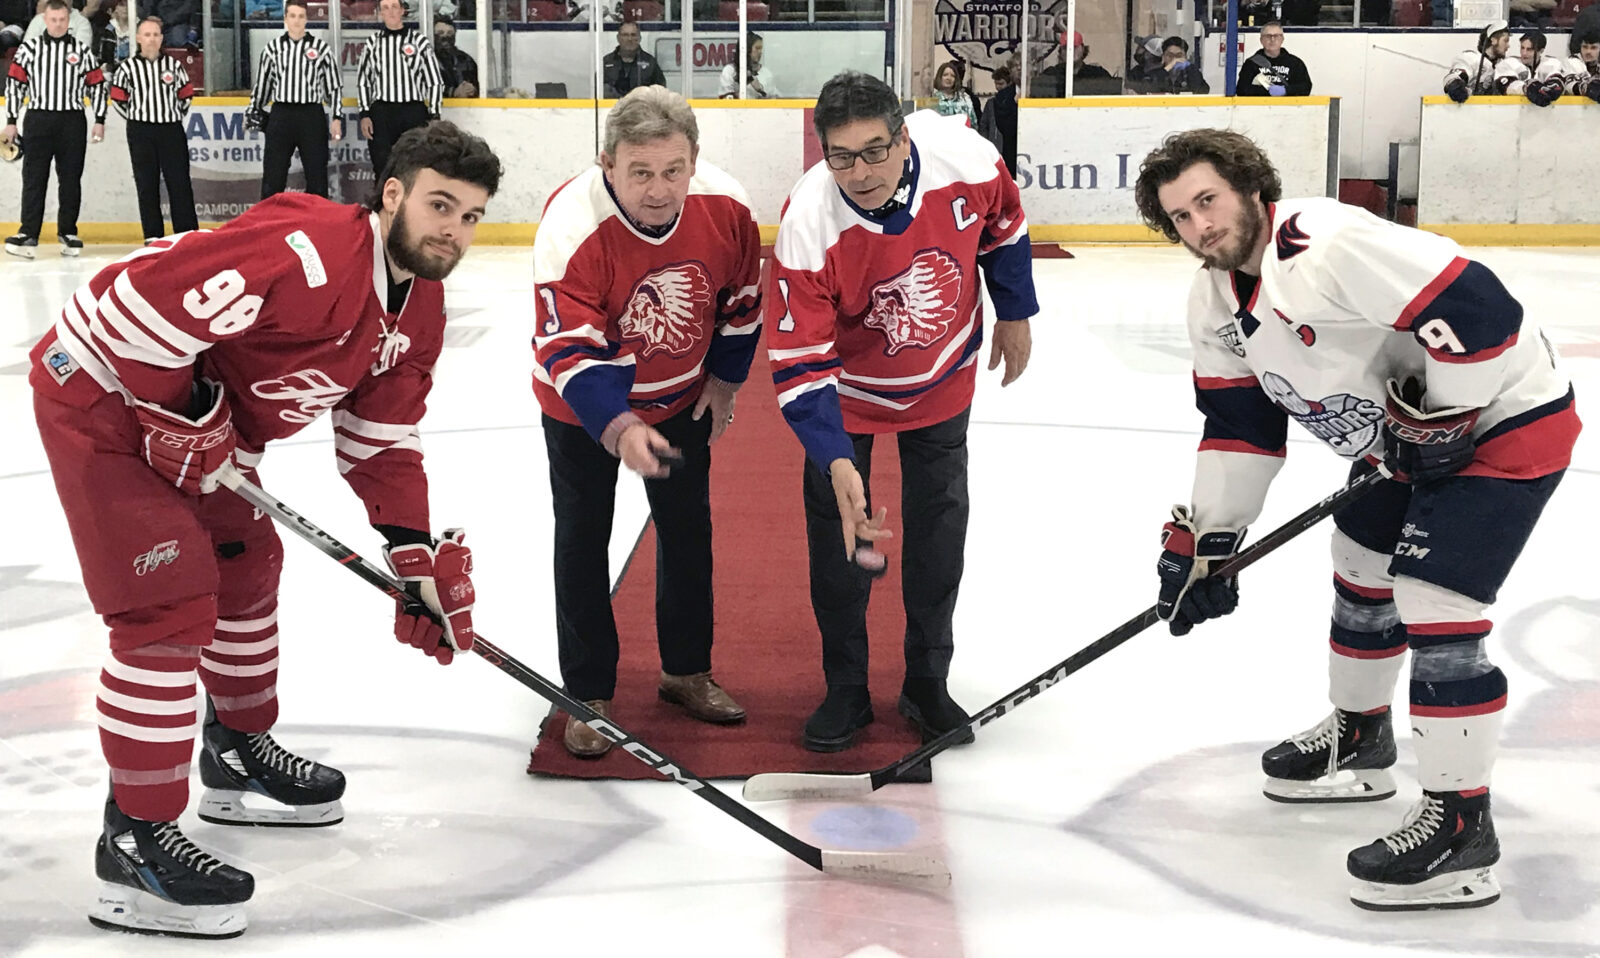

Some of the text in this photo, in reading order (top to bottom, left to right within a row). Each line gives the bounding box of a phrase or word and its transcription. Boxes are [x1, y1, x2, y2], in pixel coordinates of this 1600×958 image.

[631, 8, 643, 17] 14
[1573, 4, 1580, 13] 4
[223, 144, 262, 162] rent
[1016, 153, 1099, 190] Sun
[951, 196, 979, 232] C
[182, 268, 264, 335] 98
[1416, 317, 1467, 355] 9
[1386, 420, 1472, 446] CM
[275, 502, 342, 548] CCM
[1393, 541, 1432, 560] CM
[585, 718, 706, 792] CCM
[1426, 847, 1453, 873] BAUER
